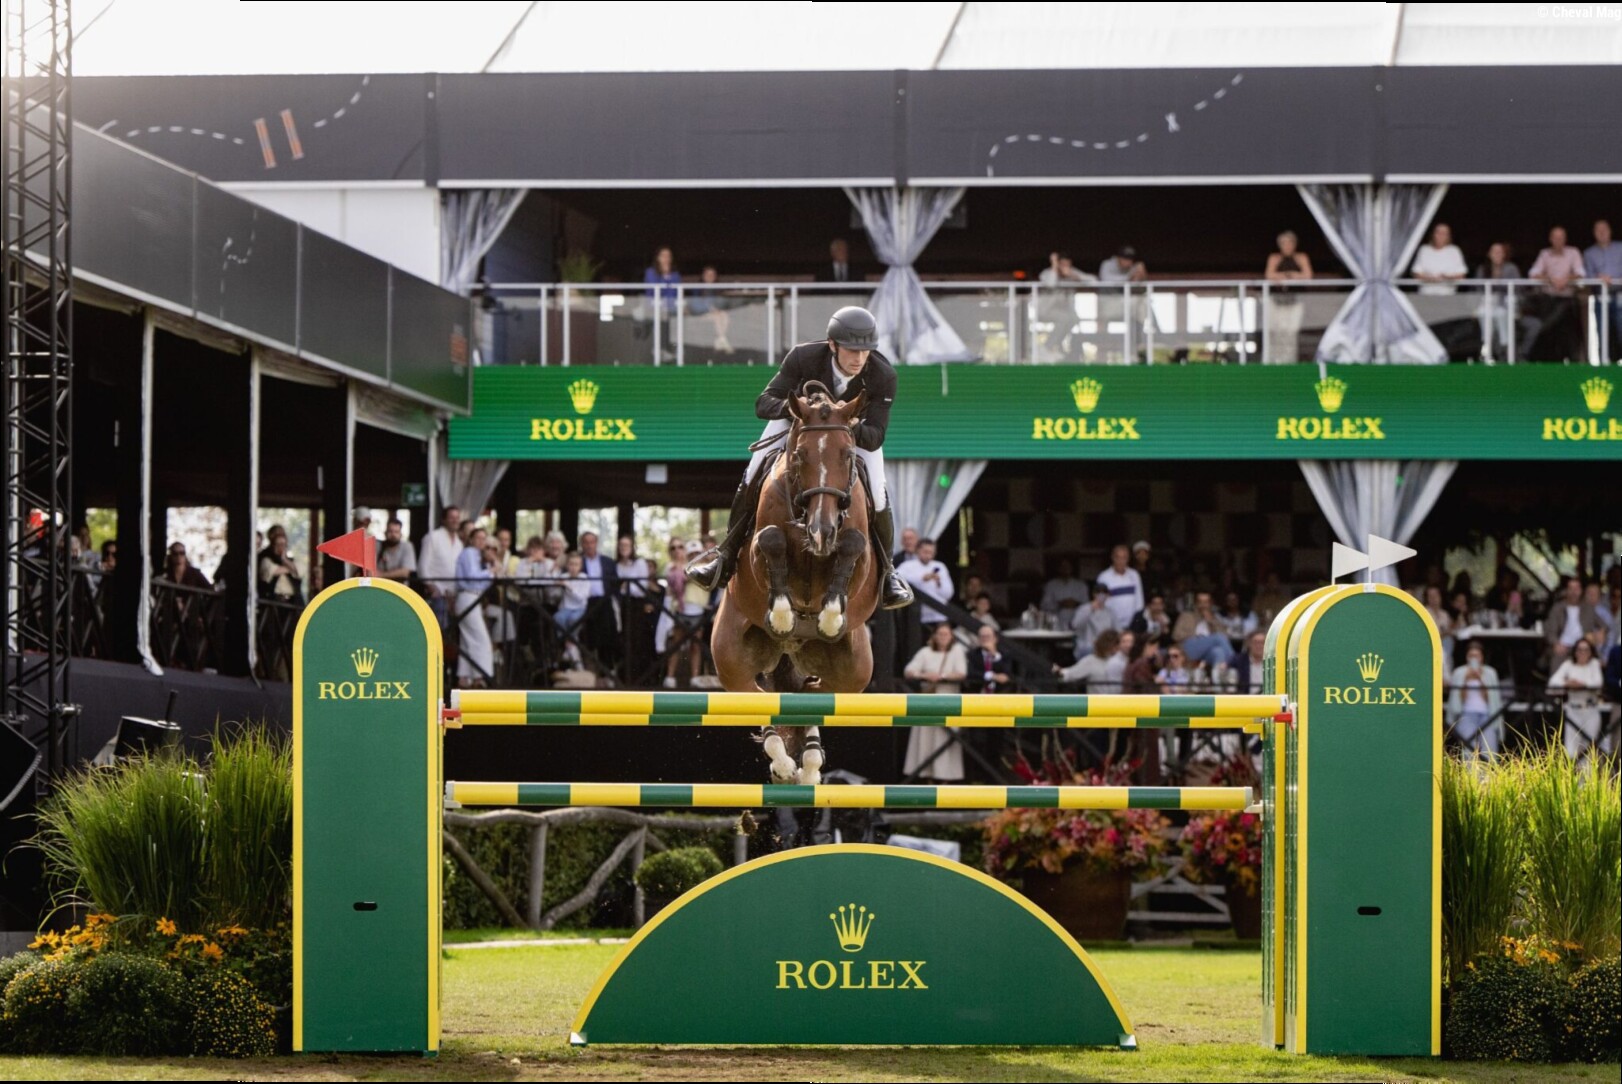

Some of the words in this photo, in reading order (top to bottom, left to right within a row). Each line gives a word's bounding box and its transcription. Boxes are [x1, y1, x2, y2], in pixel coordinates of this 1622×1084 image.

[530, 419, 637, 440] ROLEX
[1032, 418, 1141, 440] ROLEX
[1276, 418, 1386, 440] ROLEX
[318, 681, 412, 699] ROLEX
[1323, 686, 1417, 704] ROLEX
[775, 960, 929, 989] ROLEX
